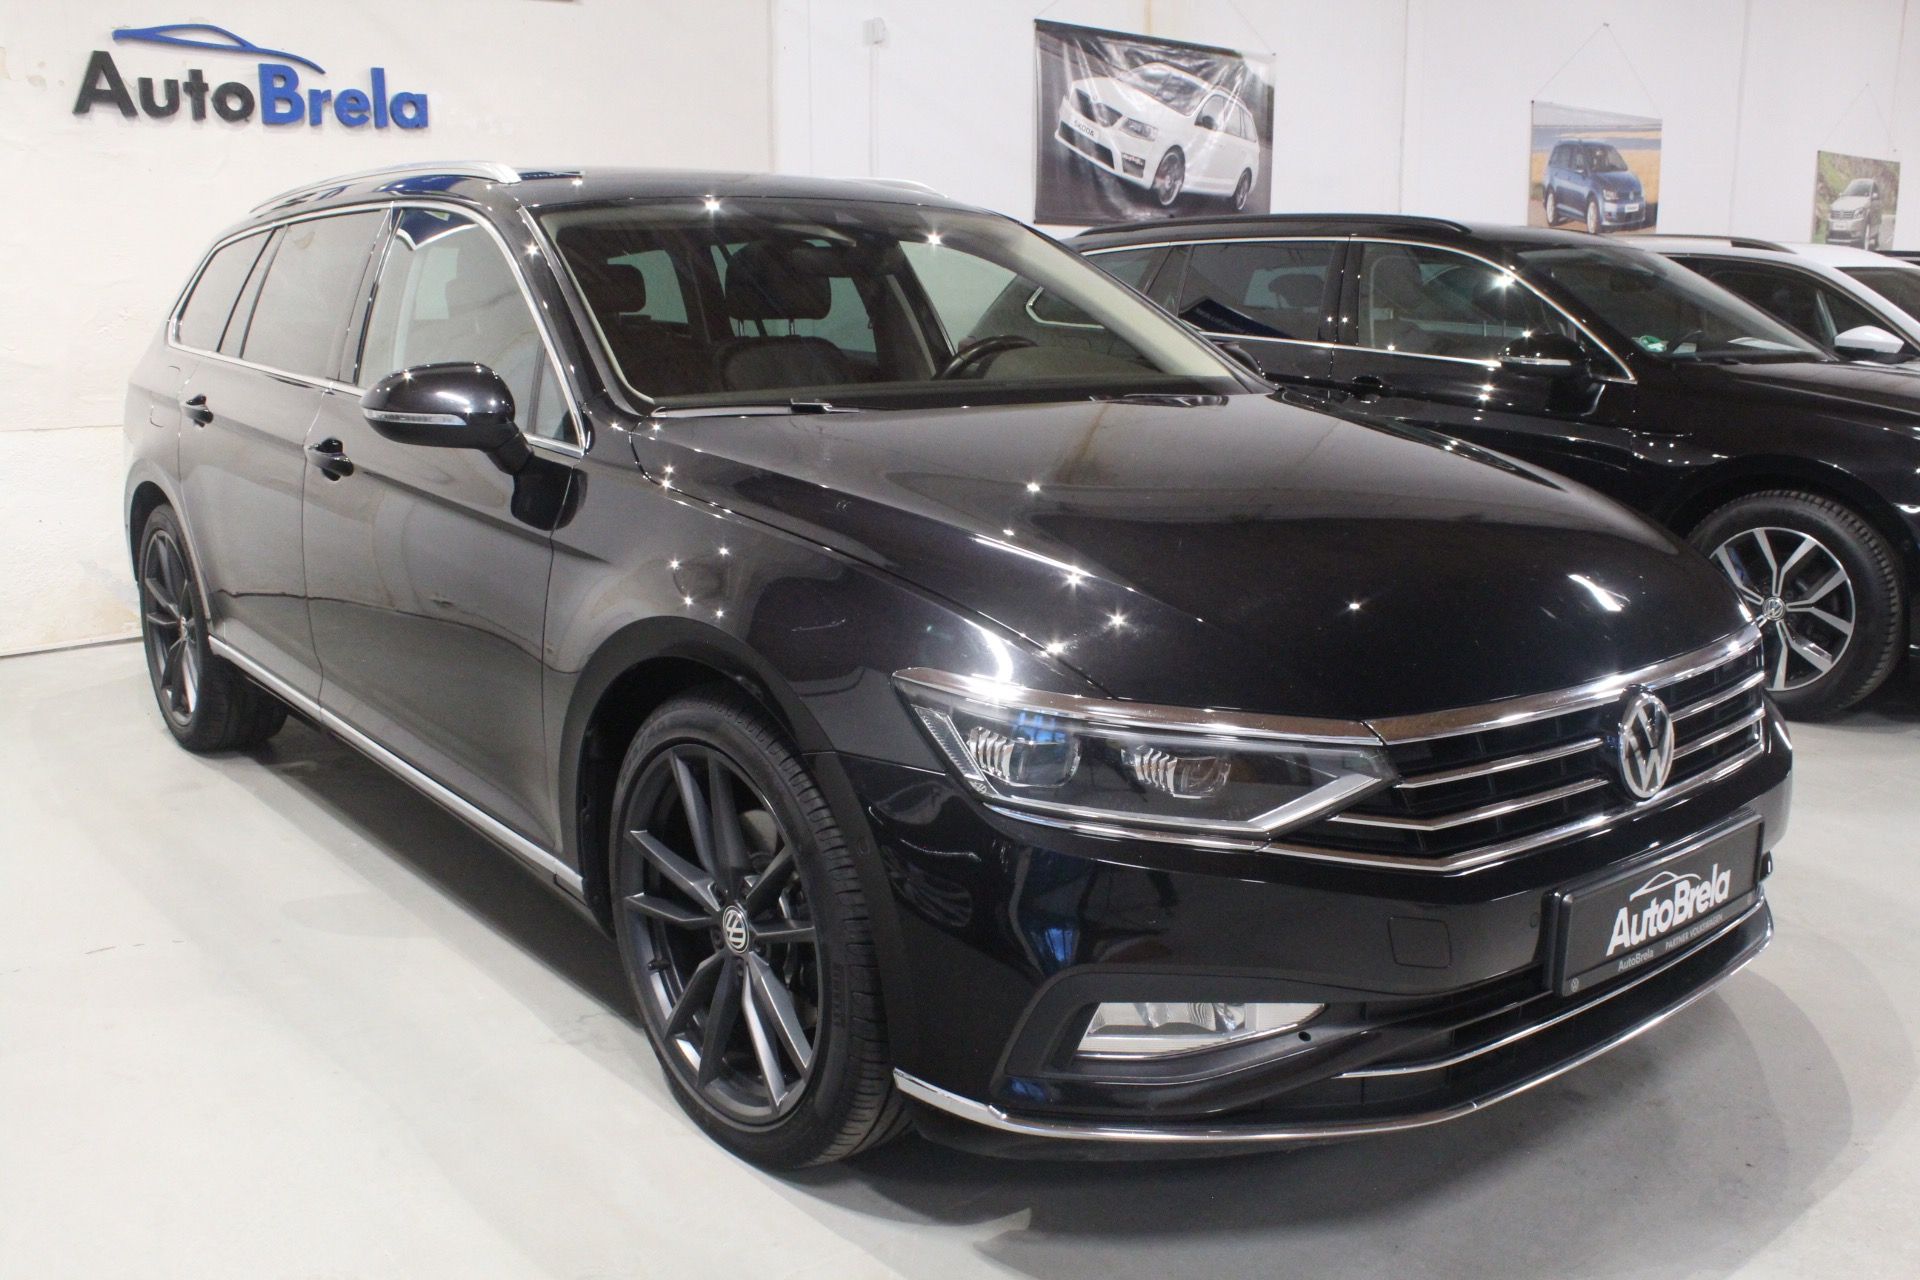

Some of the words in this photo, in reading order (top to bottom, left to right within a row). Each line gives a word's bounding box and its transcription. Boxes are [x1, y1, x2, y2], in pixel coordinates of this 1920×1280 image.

[73, 50, 429, 129] AutoBrela
[1606, 863, 1731, 957] AutoBrela
[1617, 949, 1655, 973] AutoBrela
